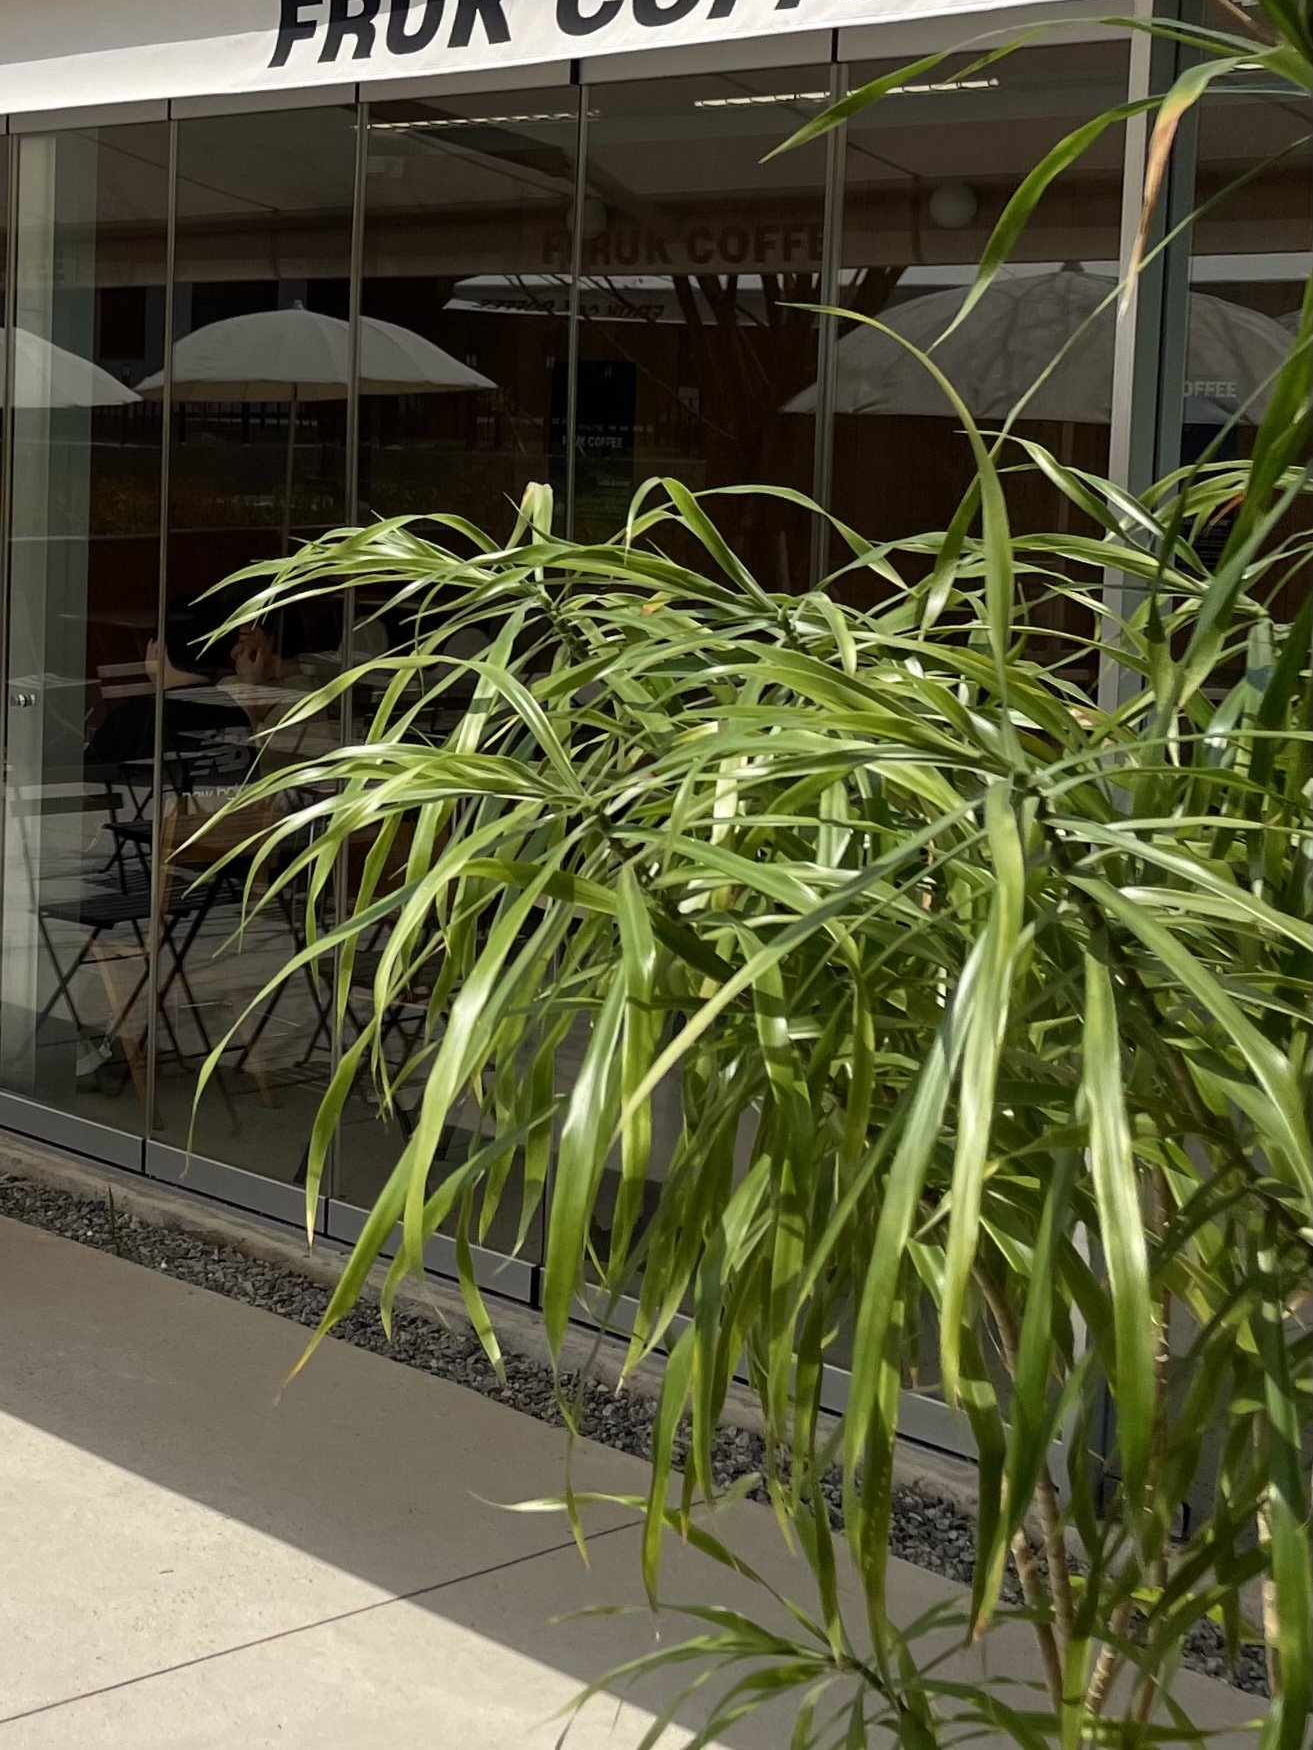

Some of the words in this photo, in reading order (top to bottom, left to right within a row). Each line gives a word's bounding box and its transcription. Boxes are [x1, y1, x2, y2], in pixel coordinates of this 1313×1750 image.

[685, 222, 824, 265] COFFE
[1182, 380, 1238, 399] OFFEE
[588, 436, 624, 449] COFFEE
